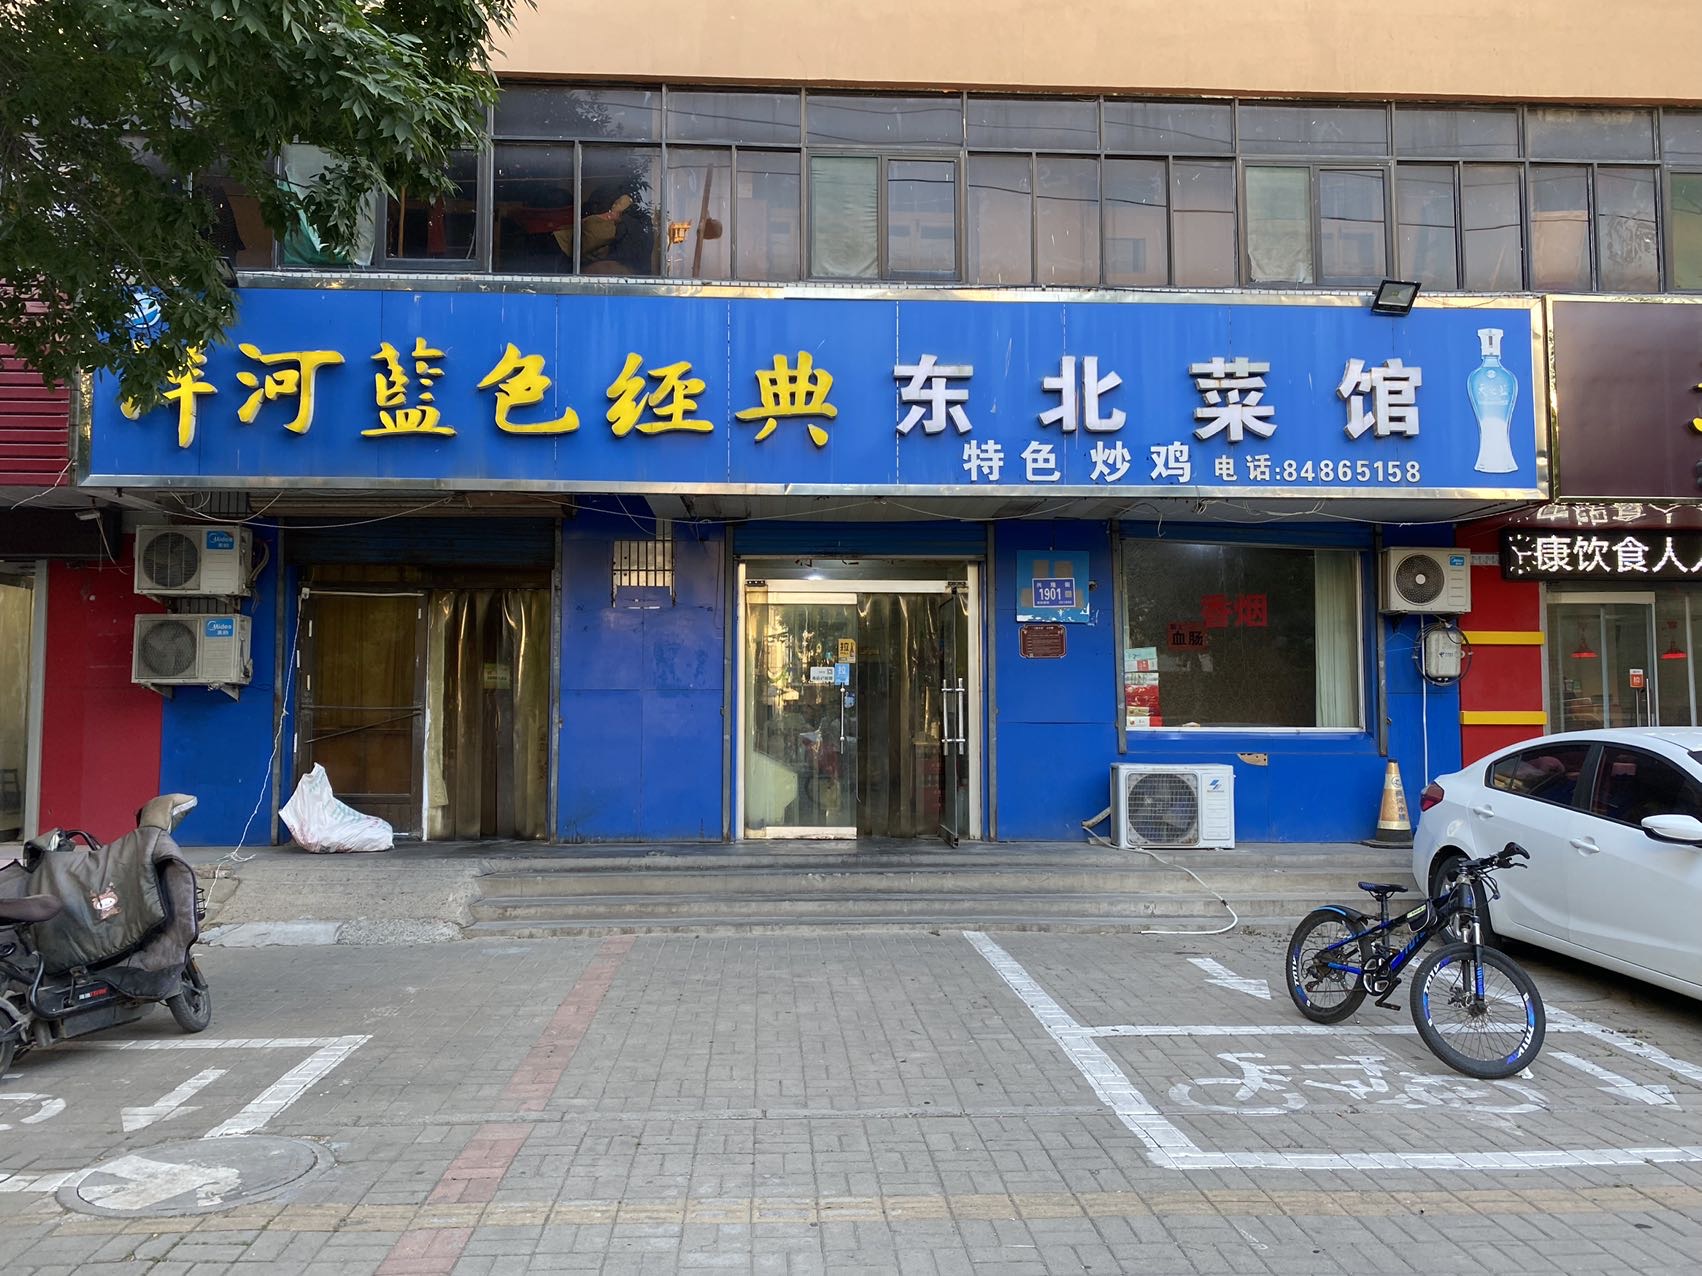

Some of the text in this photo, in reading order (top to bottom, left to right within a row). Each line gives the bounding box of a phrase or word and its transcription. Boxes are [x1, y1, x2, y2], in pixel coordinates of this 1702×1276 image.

[893, 353, 1423, 443] 东北菜馆
[962, 439, 1421, 483] 特色炒鸡 电话:84865158
[1039, 588, 1061, 601] 1901
[1172, 631, 1203, 646] 血肠
